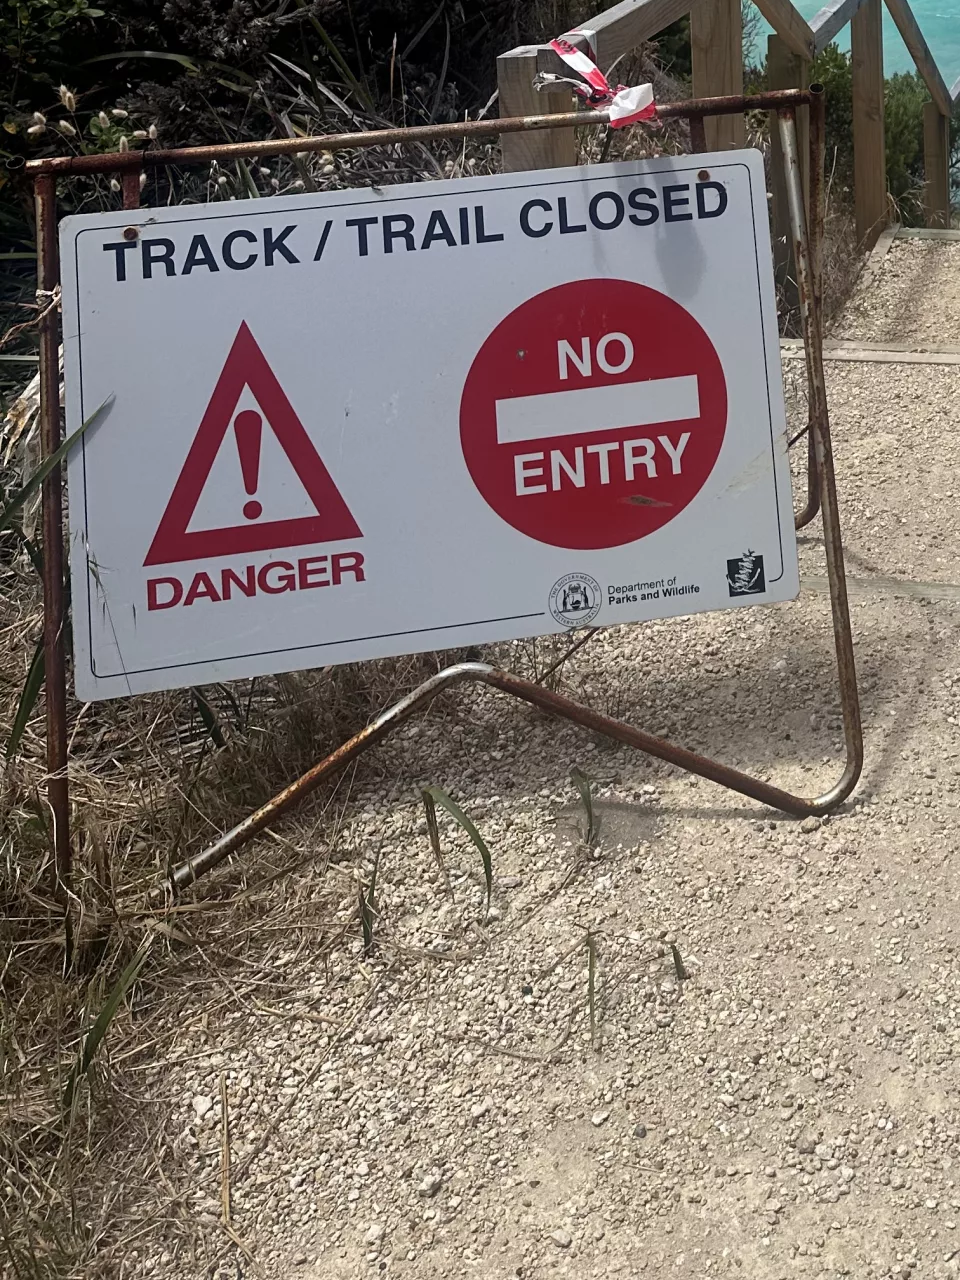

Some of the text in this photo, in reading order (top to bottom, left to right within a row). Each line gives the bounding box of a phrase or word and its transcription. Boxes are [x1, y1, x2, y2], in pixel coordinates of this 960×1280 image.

[102, 180, 729, 282] TRACK / TRAIL CLOSED
[557, 332, 635, 380] NO
[513, 432, 692, 497] ENTRY
[147, 551, 366, 611] DANGER
[607, 576, 677, 595] Department of
[608, 584, 700, 606] Parks and Wildlife
